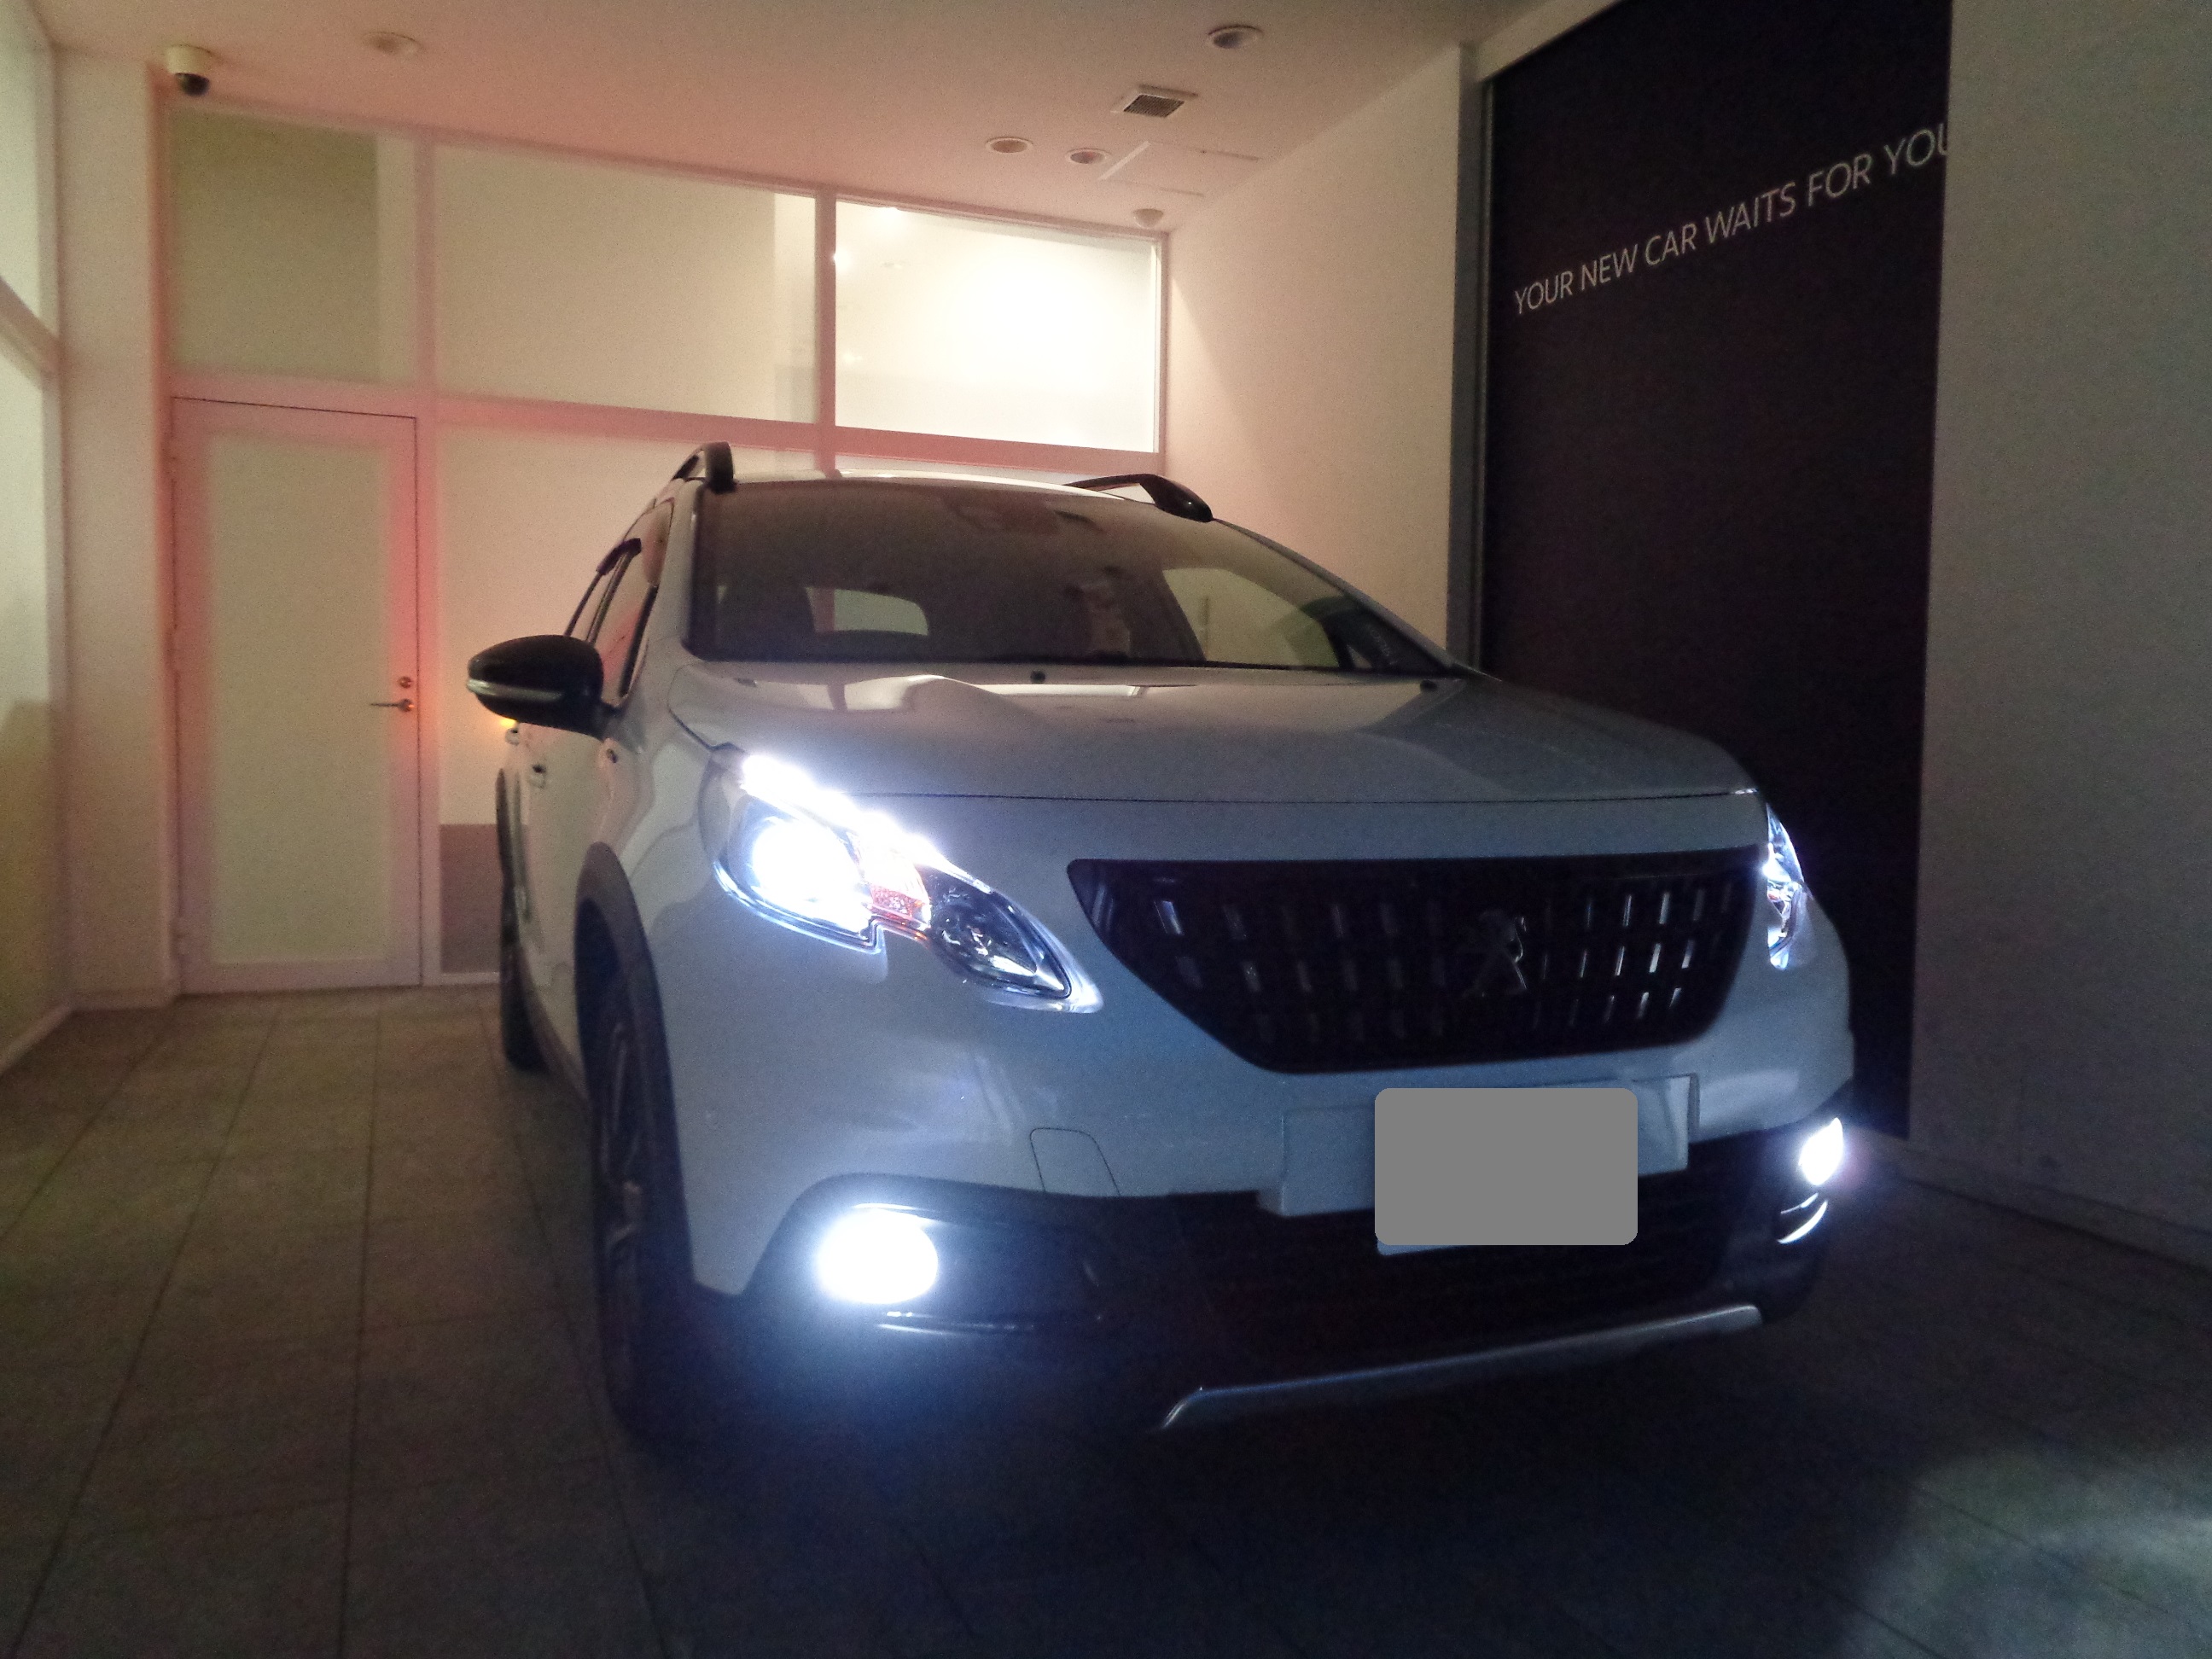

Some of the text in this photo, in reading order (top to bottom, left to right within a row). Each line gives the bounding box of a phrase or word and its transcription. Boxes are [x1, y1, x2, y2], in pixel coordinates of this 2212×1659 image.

[1514, 271, 1572, 315] YOUR
[1580, 245, 1639, 290] NEW
[1644, 224, 1697, 265] CAR
[1704, 183, 1796, 244] WAITS
[1807, 153, 1872, 207] FOR
